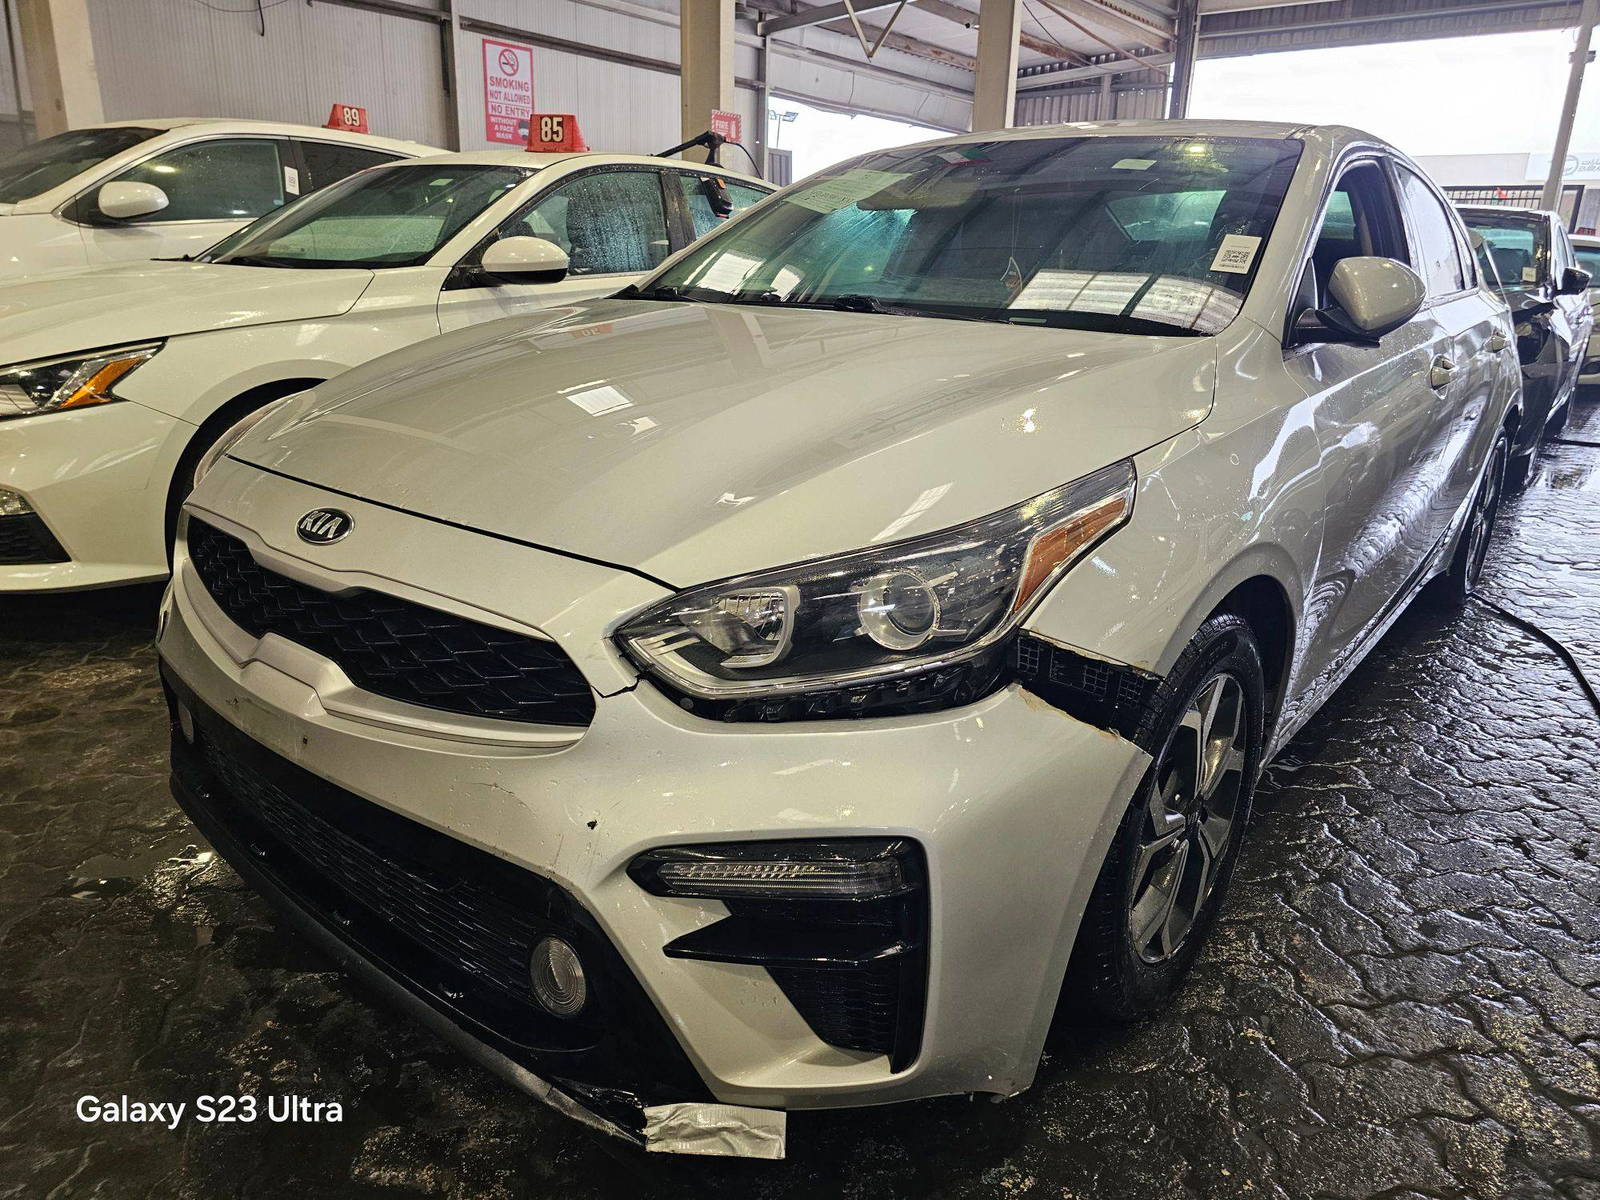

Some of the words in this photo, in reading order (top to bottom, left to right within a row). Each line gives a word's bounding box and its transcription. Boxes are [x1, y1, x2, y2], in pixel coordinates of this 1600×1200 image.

[490, 76, 529, 92] SMOKING
[490, 90, 502, 101] NOT
[503, 92, 530, 105] ALLOWED
[344, 107, 360, 127] 89
[491, 103, 502, 114] NO
[505, 105, 530, 117] ENTRY
[541, 116, 564, 142] 85
[300, 511, 343, 538] KIA
